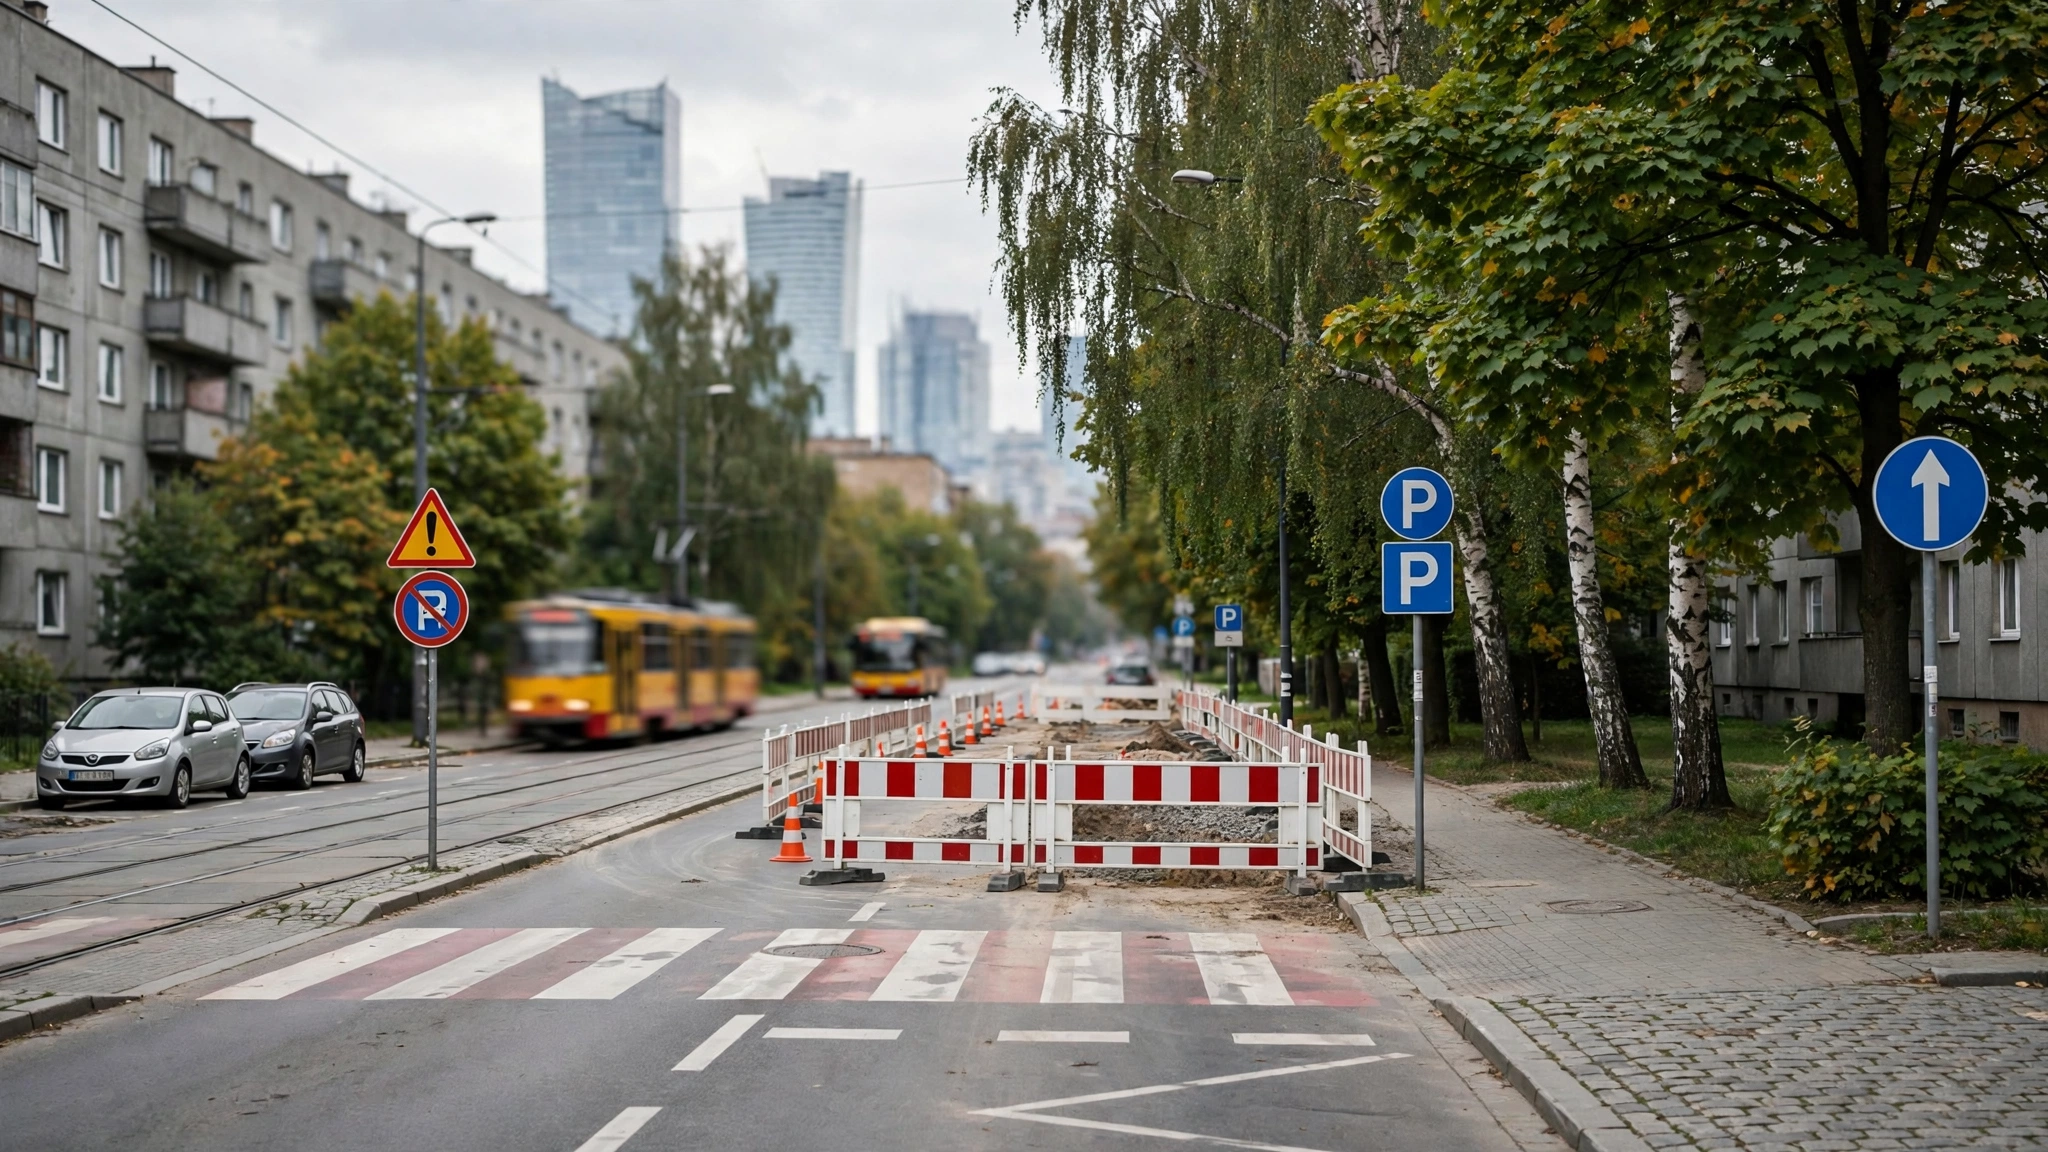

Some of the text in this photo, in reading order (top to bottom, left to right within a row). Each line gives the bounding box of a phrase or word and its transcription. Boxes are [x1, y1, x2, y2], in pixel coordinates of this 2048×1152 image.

[1402, 480, 1437, 529] P
[1400, 552, 1439, 605] P
[1179, 620, 1191, 636] P
[1222, 608, 1237, 628] P
